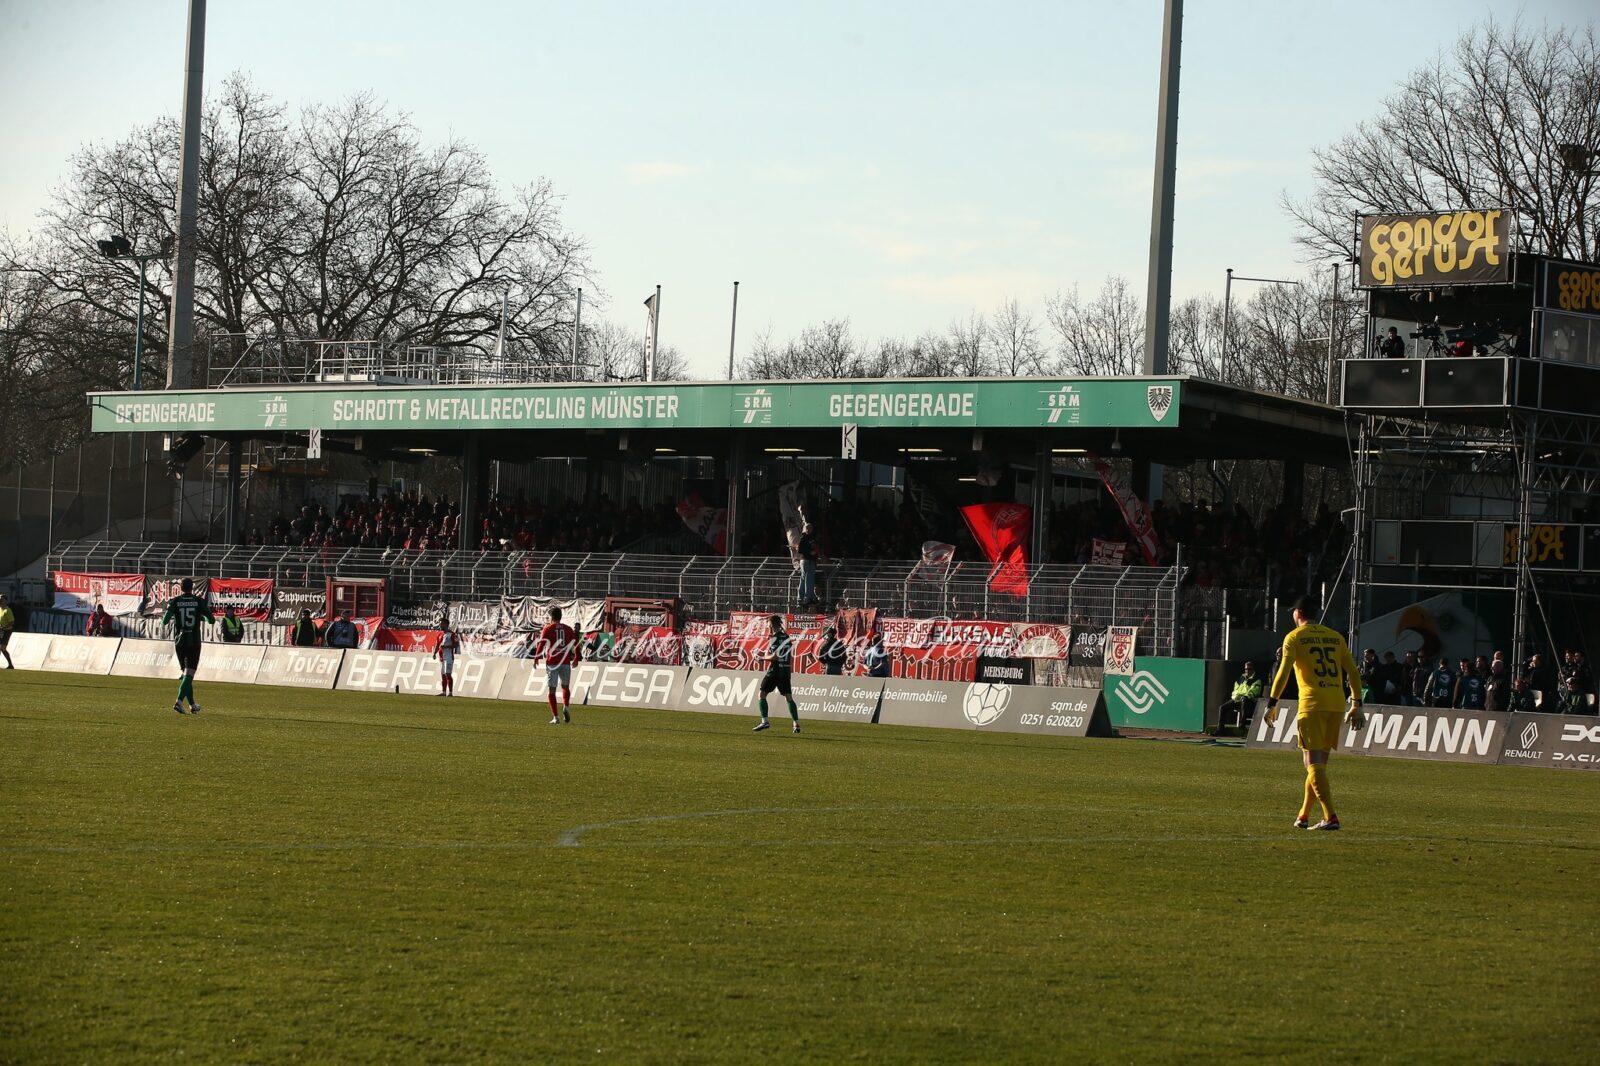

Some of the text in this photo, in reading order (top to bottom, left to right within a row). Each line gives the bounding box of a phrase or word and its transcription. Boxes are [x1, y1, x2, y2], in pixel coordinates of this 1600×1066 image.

[265, 402, 288, 413] SRM
[333, 390, 679, 421] SCHROTT & METALLRECYCLING MÜNSTER
[744, 396, 772, 409] SRM
[829, 393, 974, 418] GEGENGERADE
[1048, 394, 1080, 407] SRM
[115, 403, 216, 423] GEGENGERADE
[311, 430, 319, 448] K
[845, 425, 856, 448] K
[178, 607, 196, 628] 15
[788, 622, 822, 630] MANSFELD
[285, 650, 338, 675] Tovar
[1310, 646, 1338, 678] 35
[982, 664, 1025, 680] MERSEBURG
[522, 663, 675, 705] BRESA
[687, 675, 759, 708] SQM
[829, 686, 850, 699] Ihre
[798, 703, 820, 713] zum
[1050, 700, 1088, 713] sqm.de
[1020, 713, 1083, 728] 0251 620820
[1255, 707, 1497, 756] HATMANN
[1504, 749, 1544, 760] RENAULT
